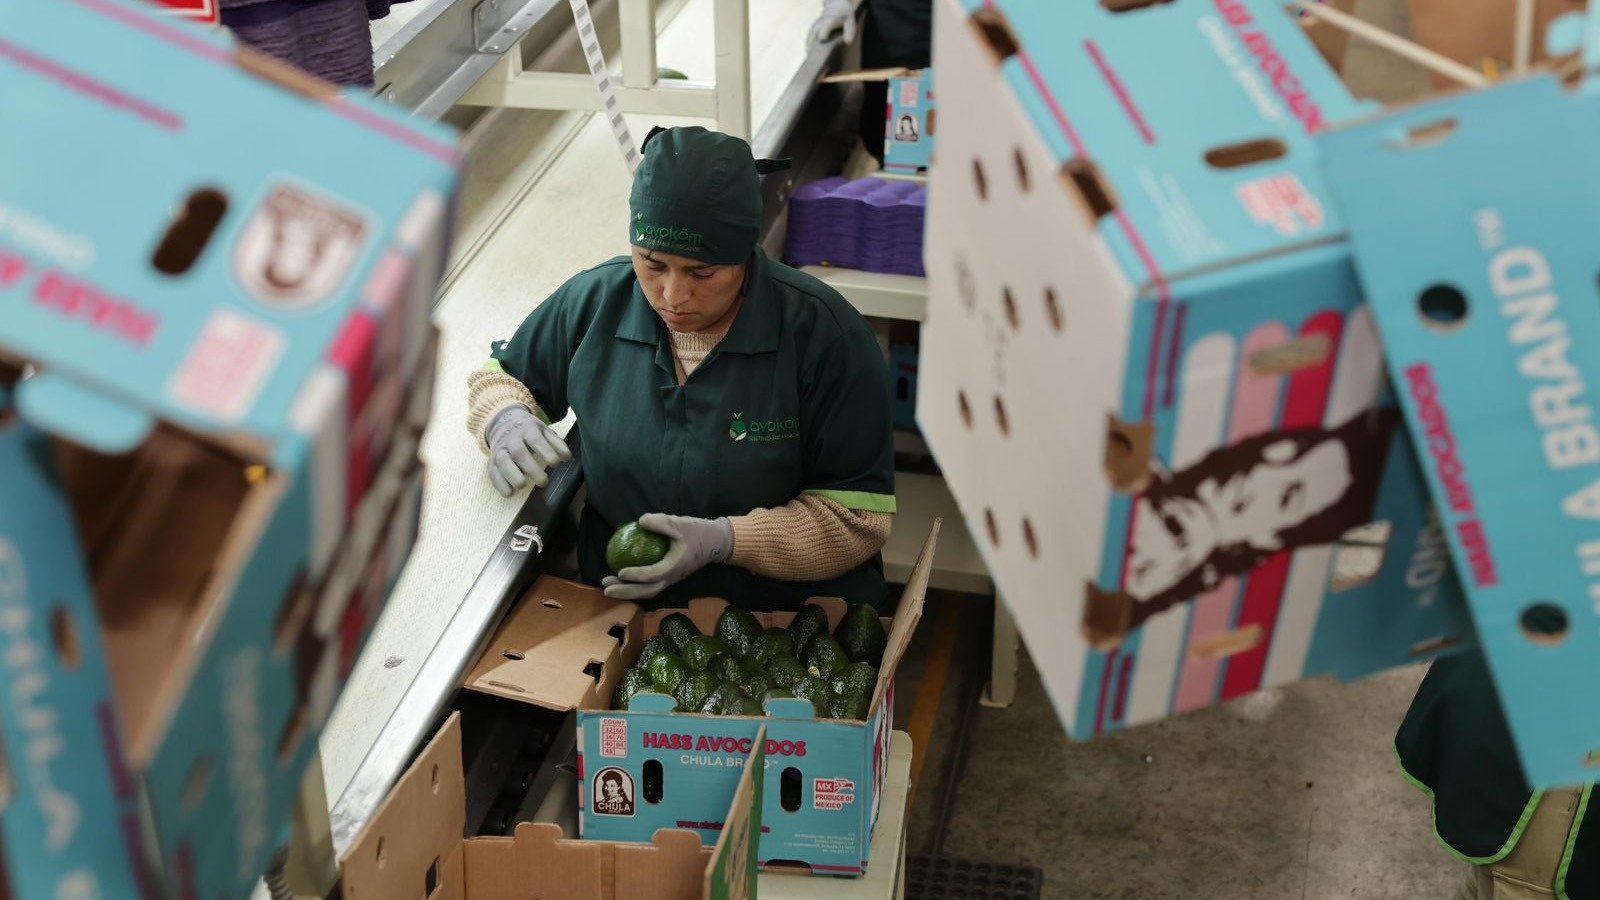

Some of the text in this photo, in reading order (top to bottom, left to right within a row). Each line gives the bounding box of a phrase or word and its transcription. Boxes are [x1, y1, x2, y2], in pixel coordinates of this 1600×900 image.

[643, 732, 807, 757] HASS AVOCDOS
[680, 754, 723, 767] CHULA
[816, 782, 832, 791] MX
[597, 802, 631, 812] CHULA
